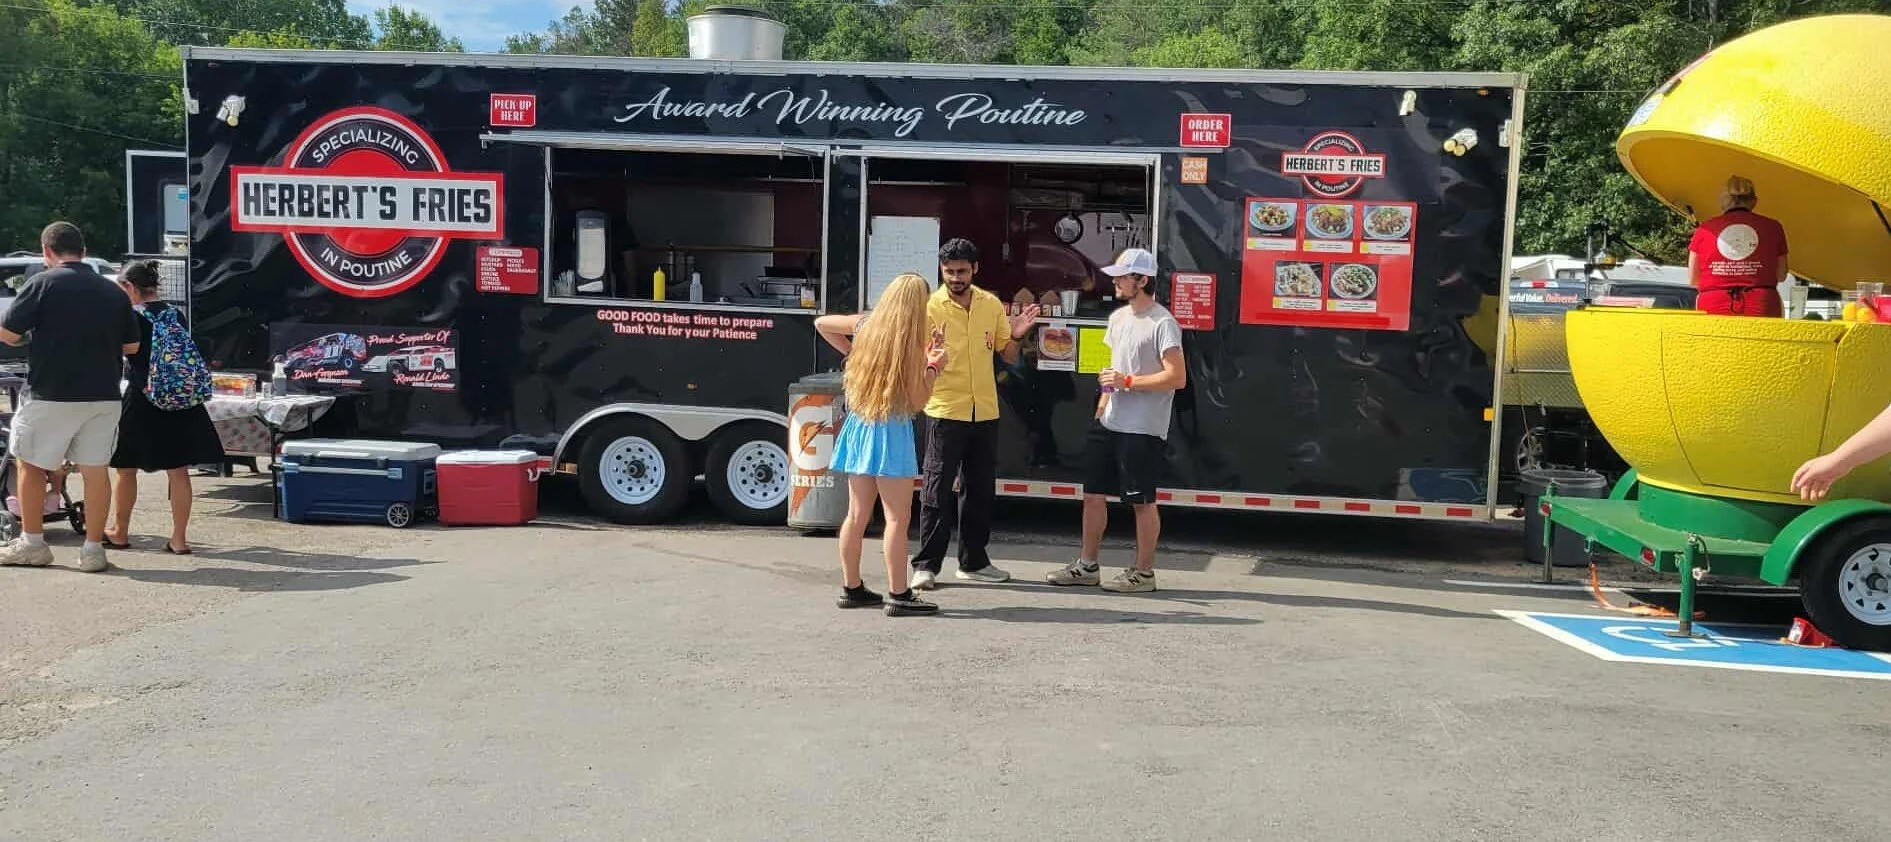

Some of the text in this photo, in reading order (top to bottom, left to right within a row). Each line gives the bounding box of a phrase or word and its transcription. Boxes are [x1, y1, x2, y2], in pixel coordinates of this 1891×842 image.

[494, 100, 532, 110] PICK UP
[614, 86, 1088, 137] Award Winning Poutine
[501, 110, 525, 121] HERE
[1188, 119, 1224, 130] ORDER
[1191, 131, 1219, 142] HERE
[312, 128, 420, 164] SPECIALIZING
[1285, 157, 1381, 173] HERBERT'S FRIES
[243, 182, 492, 223] HERBERT'S FRIES
[320, 247, 414, 278] IN POUTINE
[597, 310, 774, 329] GOOD FOOD takes time to prepare
[613, 323, 758, 340] Thank You for your Patience
[366, 333, 394, 347] Proud
